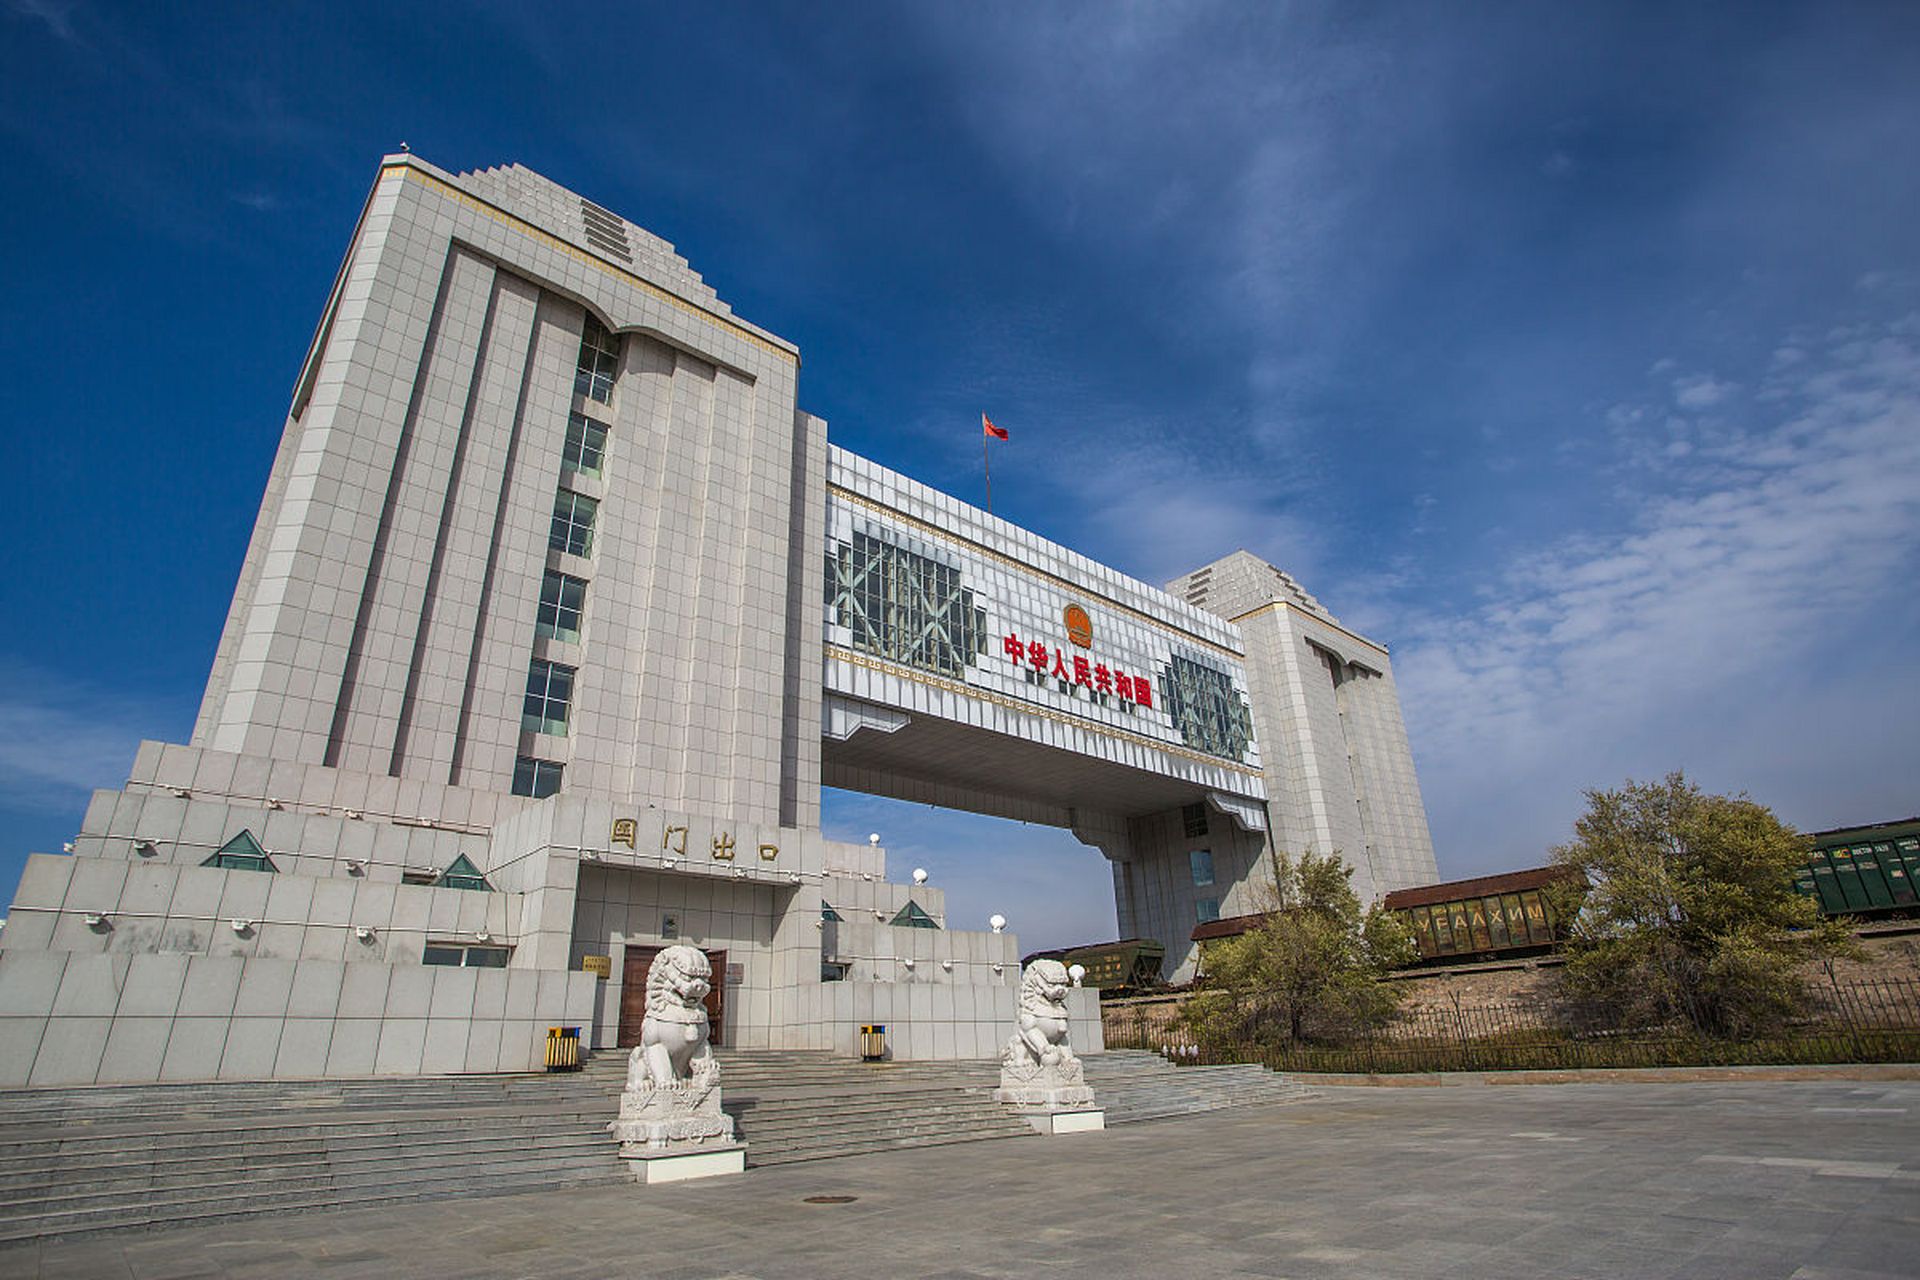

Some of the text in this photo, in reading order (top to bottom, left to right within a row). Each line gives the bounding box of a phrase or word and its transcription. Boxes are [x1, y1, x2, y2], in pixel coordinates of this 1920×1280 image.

[1004, 633, 1153, 709] 中华人民共和国
[612, 818, 779, 861] 国门出口
